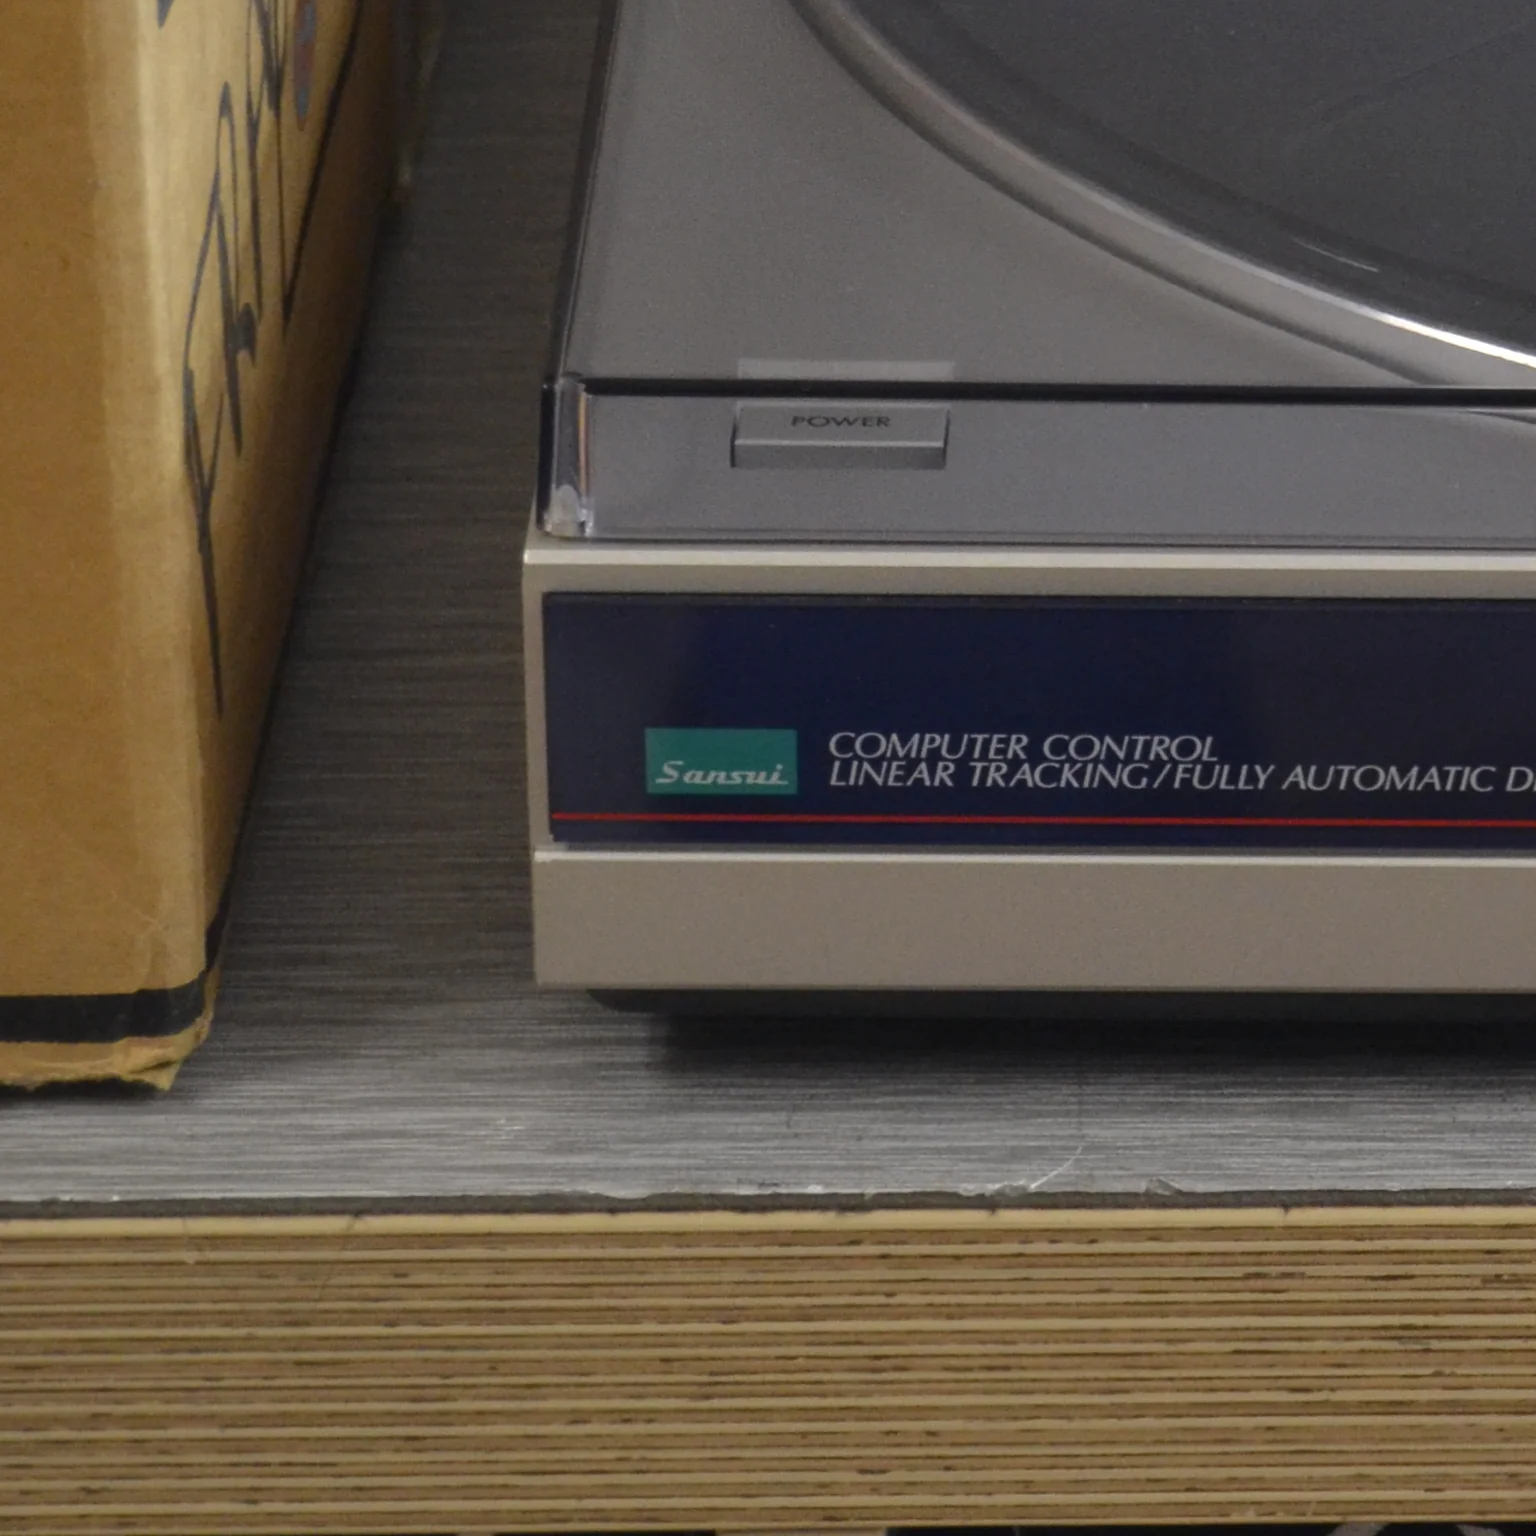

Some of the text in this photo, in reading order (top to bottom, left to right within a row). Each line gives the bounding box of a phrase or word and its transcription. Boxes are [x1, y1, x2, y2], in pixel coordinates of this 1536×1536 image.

[791, 415, 891, 428] POWER
[828, 731, 1218, 762] COMPUTER CONTROL
[655, 760, 789, 785] Sansui
[829, 760, 956, 787] LINEAR
[969, 761, 1275, 790] TRACKING/FULLY
[1281, 764, 1497, 792] AUTOMATIC
